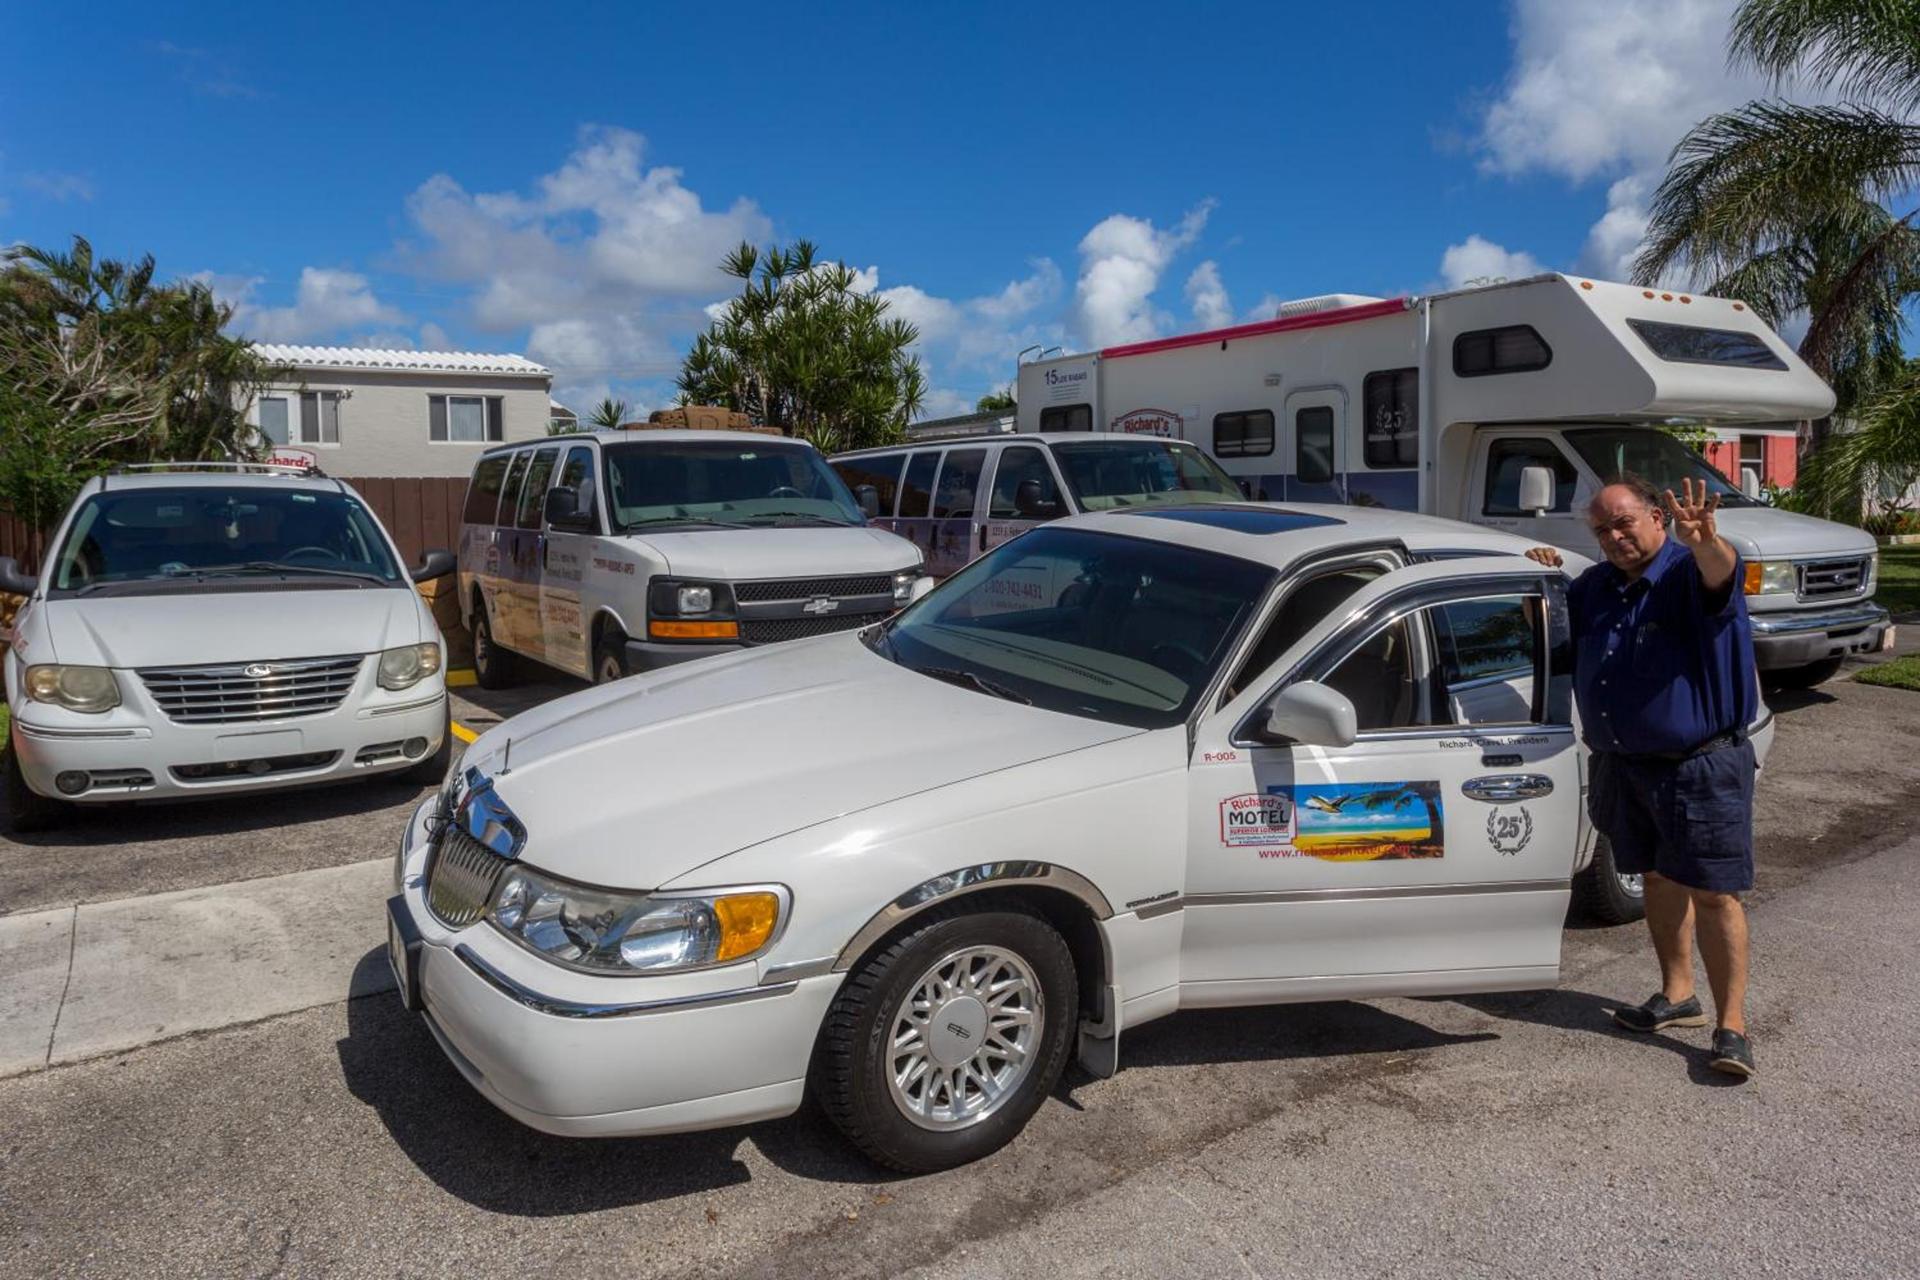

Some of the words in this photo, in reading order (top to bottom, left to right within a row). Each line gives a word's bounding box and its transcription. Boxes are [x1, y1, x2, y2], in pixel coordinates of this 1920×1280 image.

[1124, 416, 1169, 433] Richard's
[1439, 738, 1473, 749] Richard
[1203, 751, 1237, 762] R-005
[1230, 796, 1283, 811] Richard's
[1229, 810, 1290, 825] MOTEL
